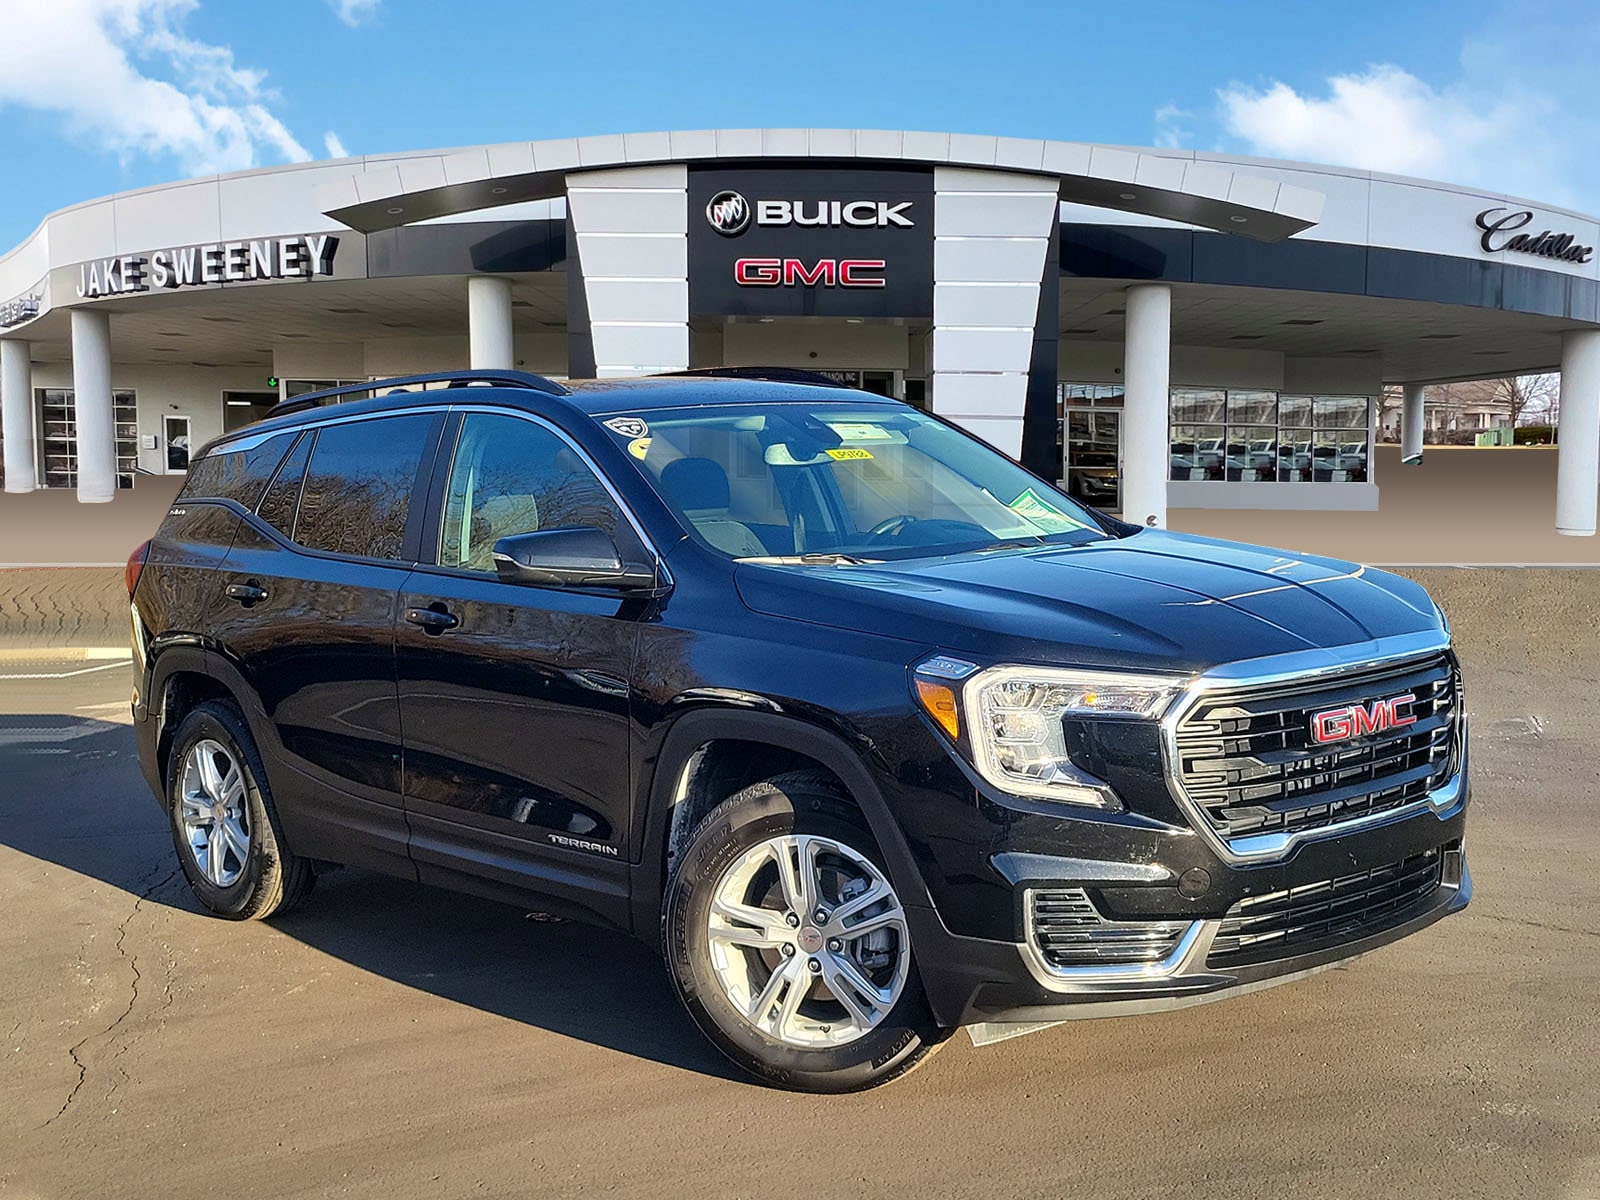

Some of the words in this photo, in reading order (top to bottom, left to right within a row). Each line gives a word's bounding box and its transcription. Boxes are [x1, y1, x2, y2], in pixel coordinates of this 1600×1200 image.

[756, 200, 916, 227] BUICK
[1475, 207, 1594, 264] Cadillac
[76, 256, 142, 299] JAKE
[151, 234, 335, 289] SWEENEY
[734, 258, 886, 287] GMC
[1310, 693, 1418, 743] GMC
[547, 834, 618, 856] TERRAIN
